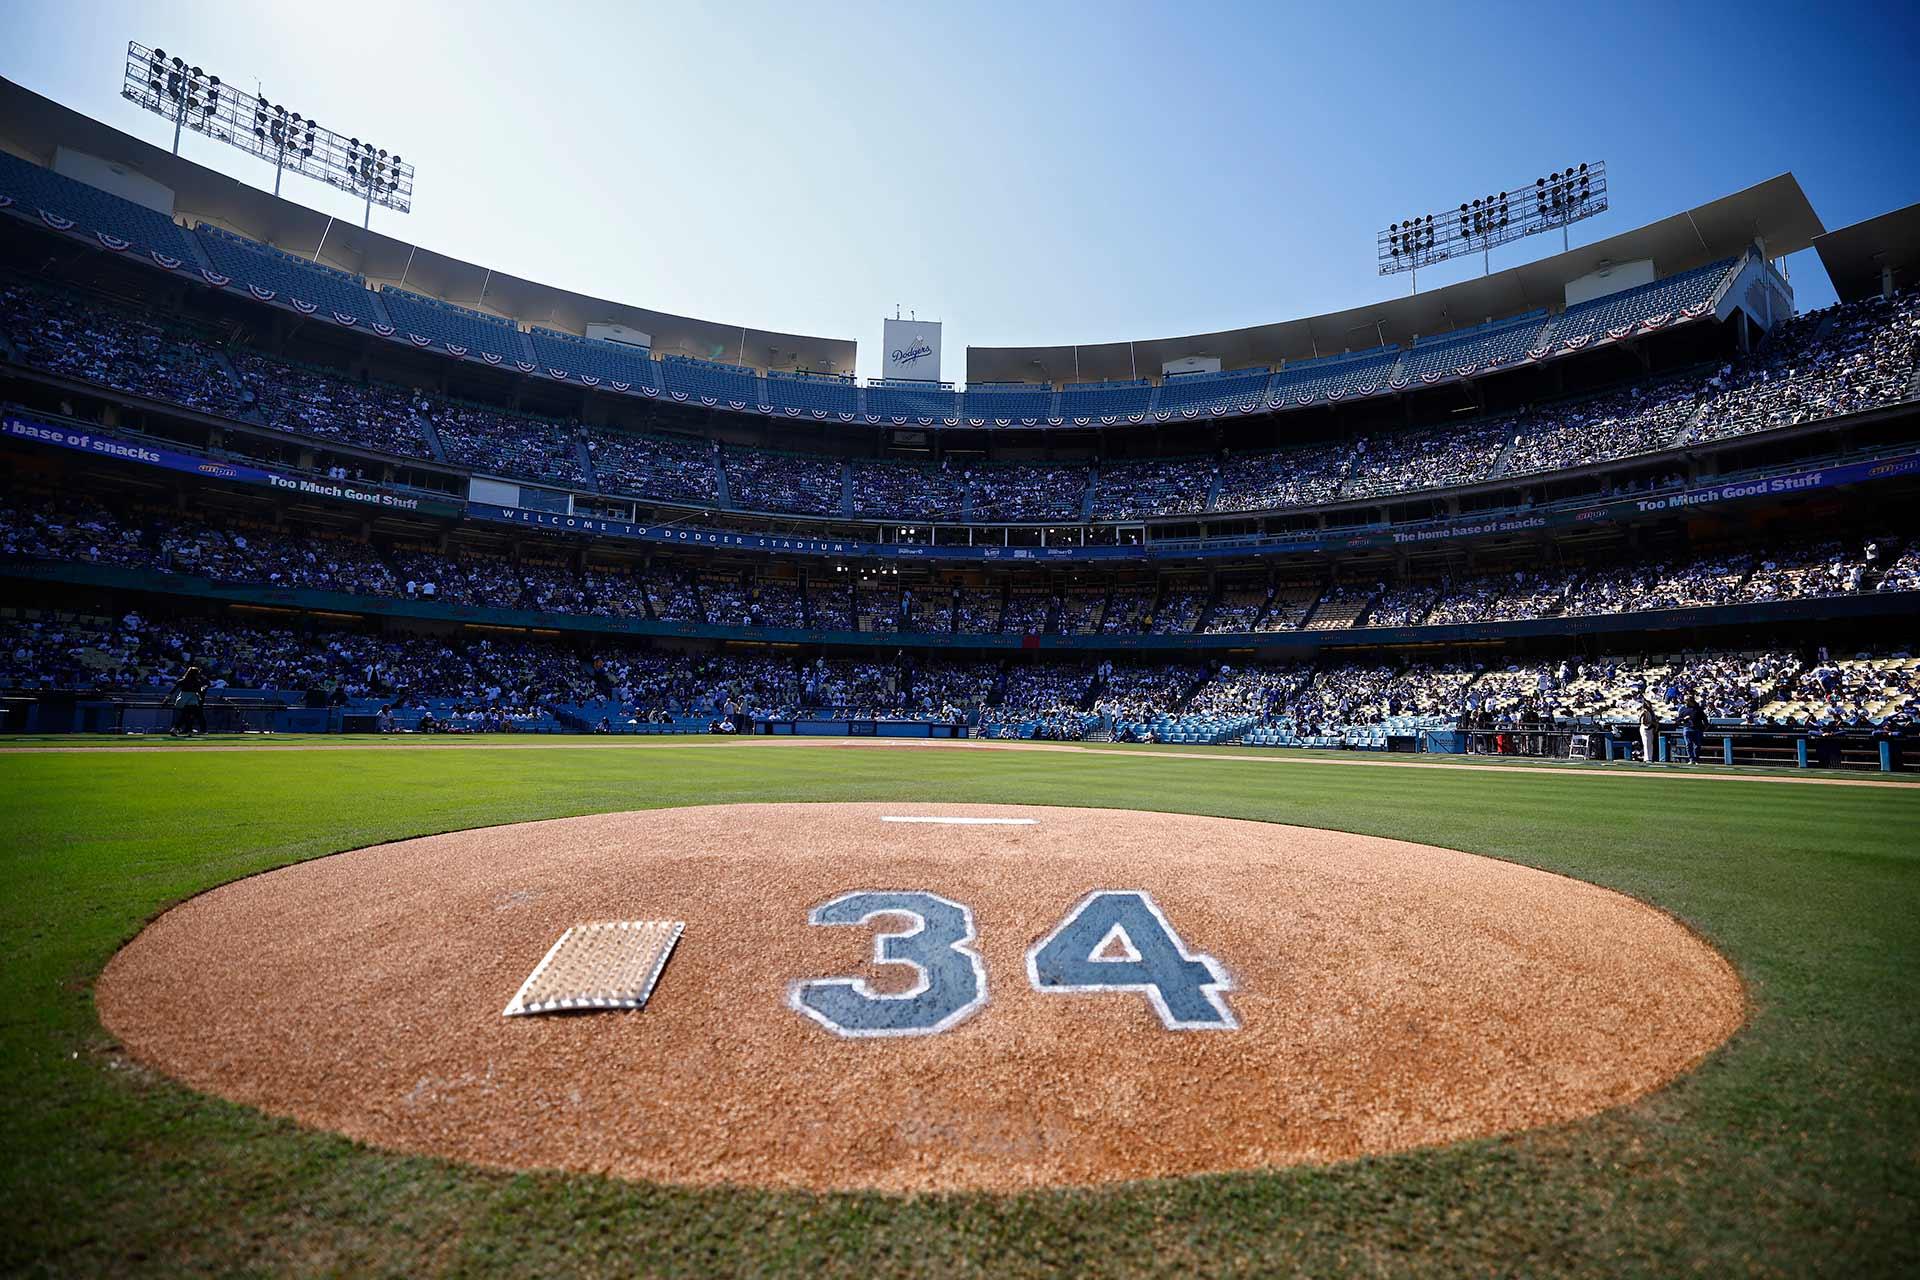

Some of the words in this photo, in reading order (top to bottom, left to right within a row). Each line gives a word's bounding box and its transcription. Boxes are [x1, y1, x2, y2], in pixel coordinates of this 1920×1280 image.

[892, 345, 932, 364] Dodgers
[12, 421, 64, 442] base
[67, 435, 90, 447] of
[93, 440, 161, 462] snacks
[198, 463, 238, 478] ampm
[268, 474, 297, 489] Too
[300, 480, 342, 497] Much
[344, 488, 380, 504] Good
[382, 495, 418, 509] Stuff
[1637, 499, 1666, 512] Too
[1669, 490, 1719, 508] Much
[1722, 480, 1768, 500] Good
[1770, 472, 1822, 492] Stuff
[502, 509, 607, 531] WELCOME
[625, 525, 647, 535] TO
[664, 529, 744, 545] DODGER
[759, 538, 843, 551] STADIUM
[1393, 532, 1415, 543] The
[1417, 529, 1450, 541] home
[1452, 526, 1482, 537] base
[1483, 521, 1497, 533] of
[1499, 517, 1546, 531] snacks
[789, 890, 1238, 1037] 34
